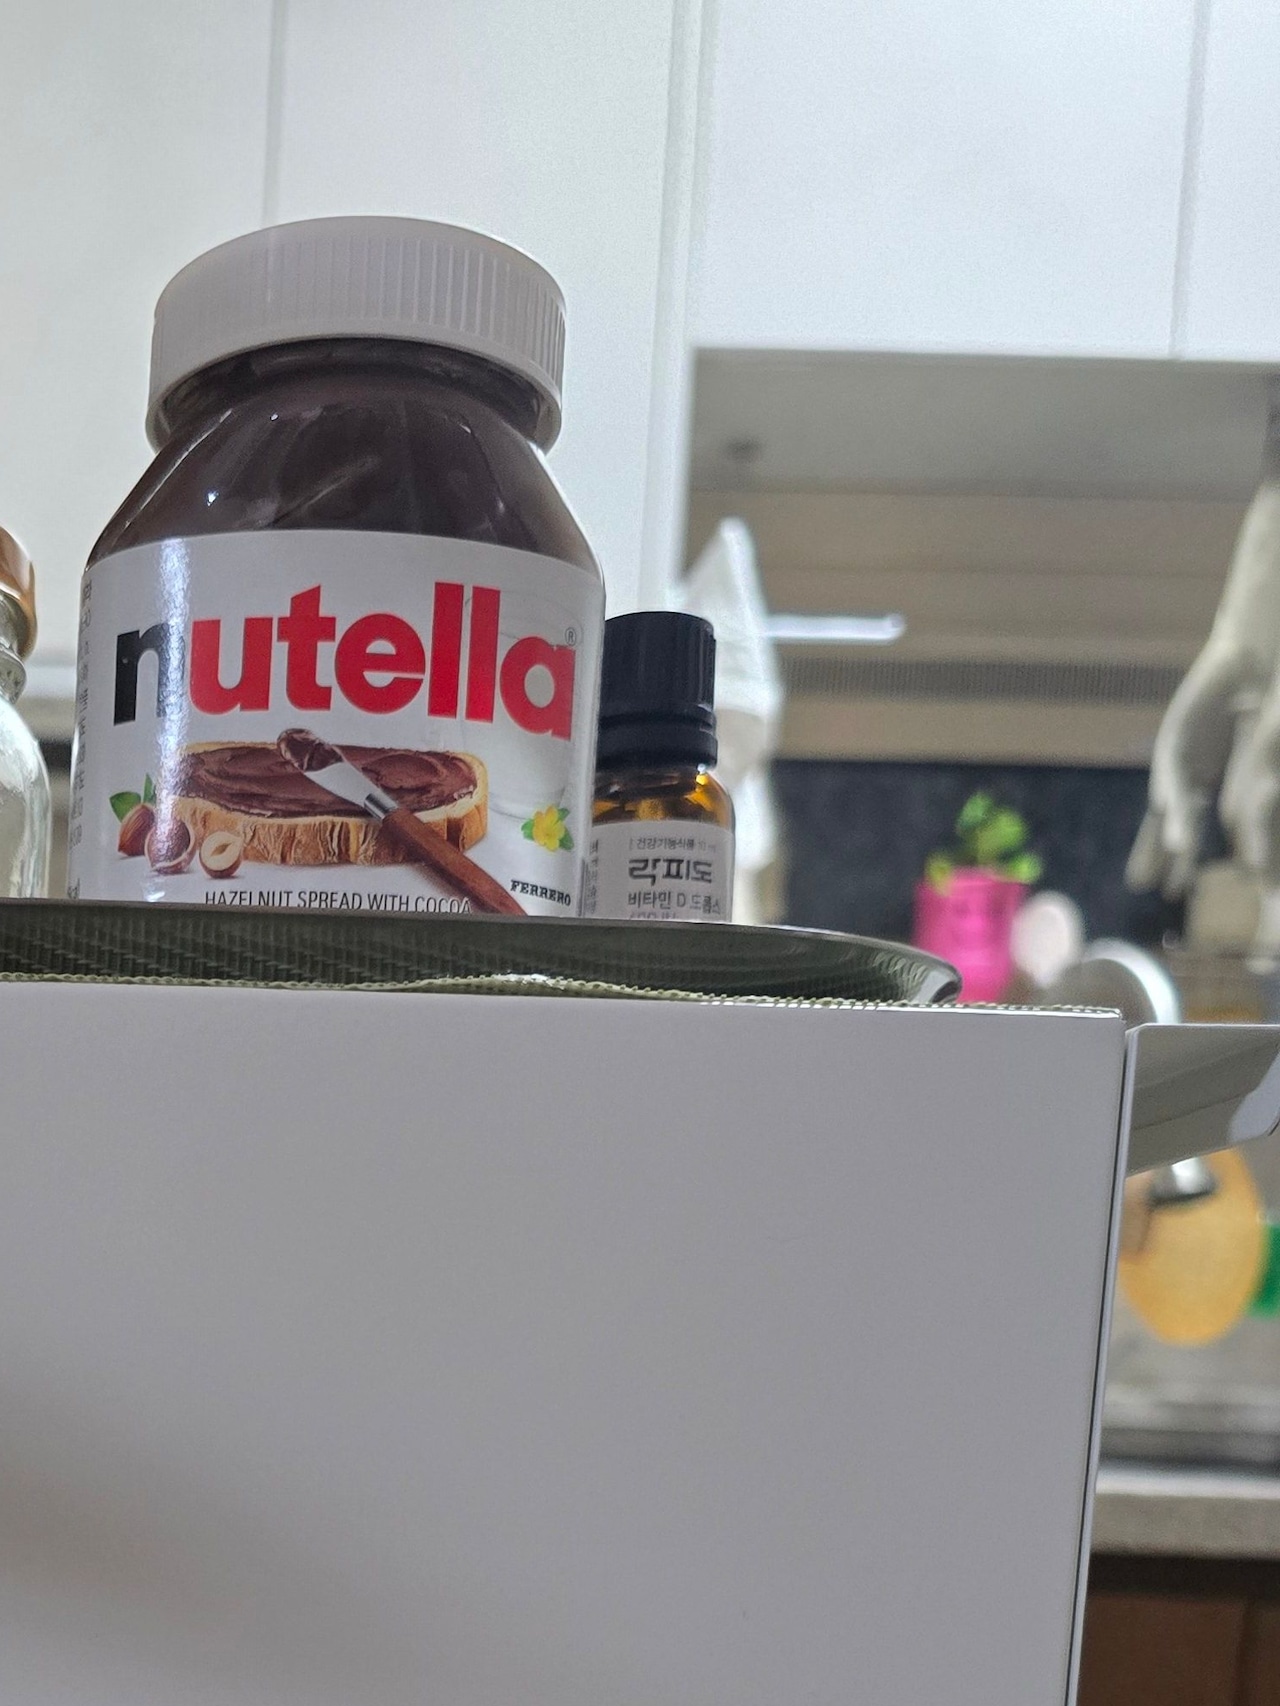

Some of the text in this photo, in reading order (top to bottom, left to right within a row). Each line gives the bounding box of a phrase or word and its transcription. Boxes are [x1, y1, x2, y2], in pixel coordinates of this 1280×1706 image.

[113, 581, 577, 741] nutella
[628, 858, 712, 886] 락피도
[205, 890, 471, 914] HAZELNUT SPREAD WITH COCOA
[510, 879, 572, 906] FERRERO
[628, 890, 671, 909] 비타민
[676, 893, 687, 908] D
